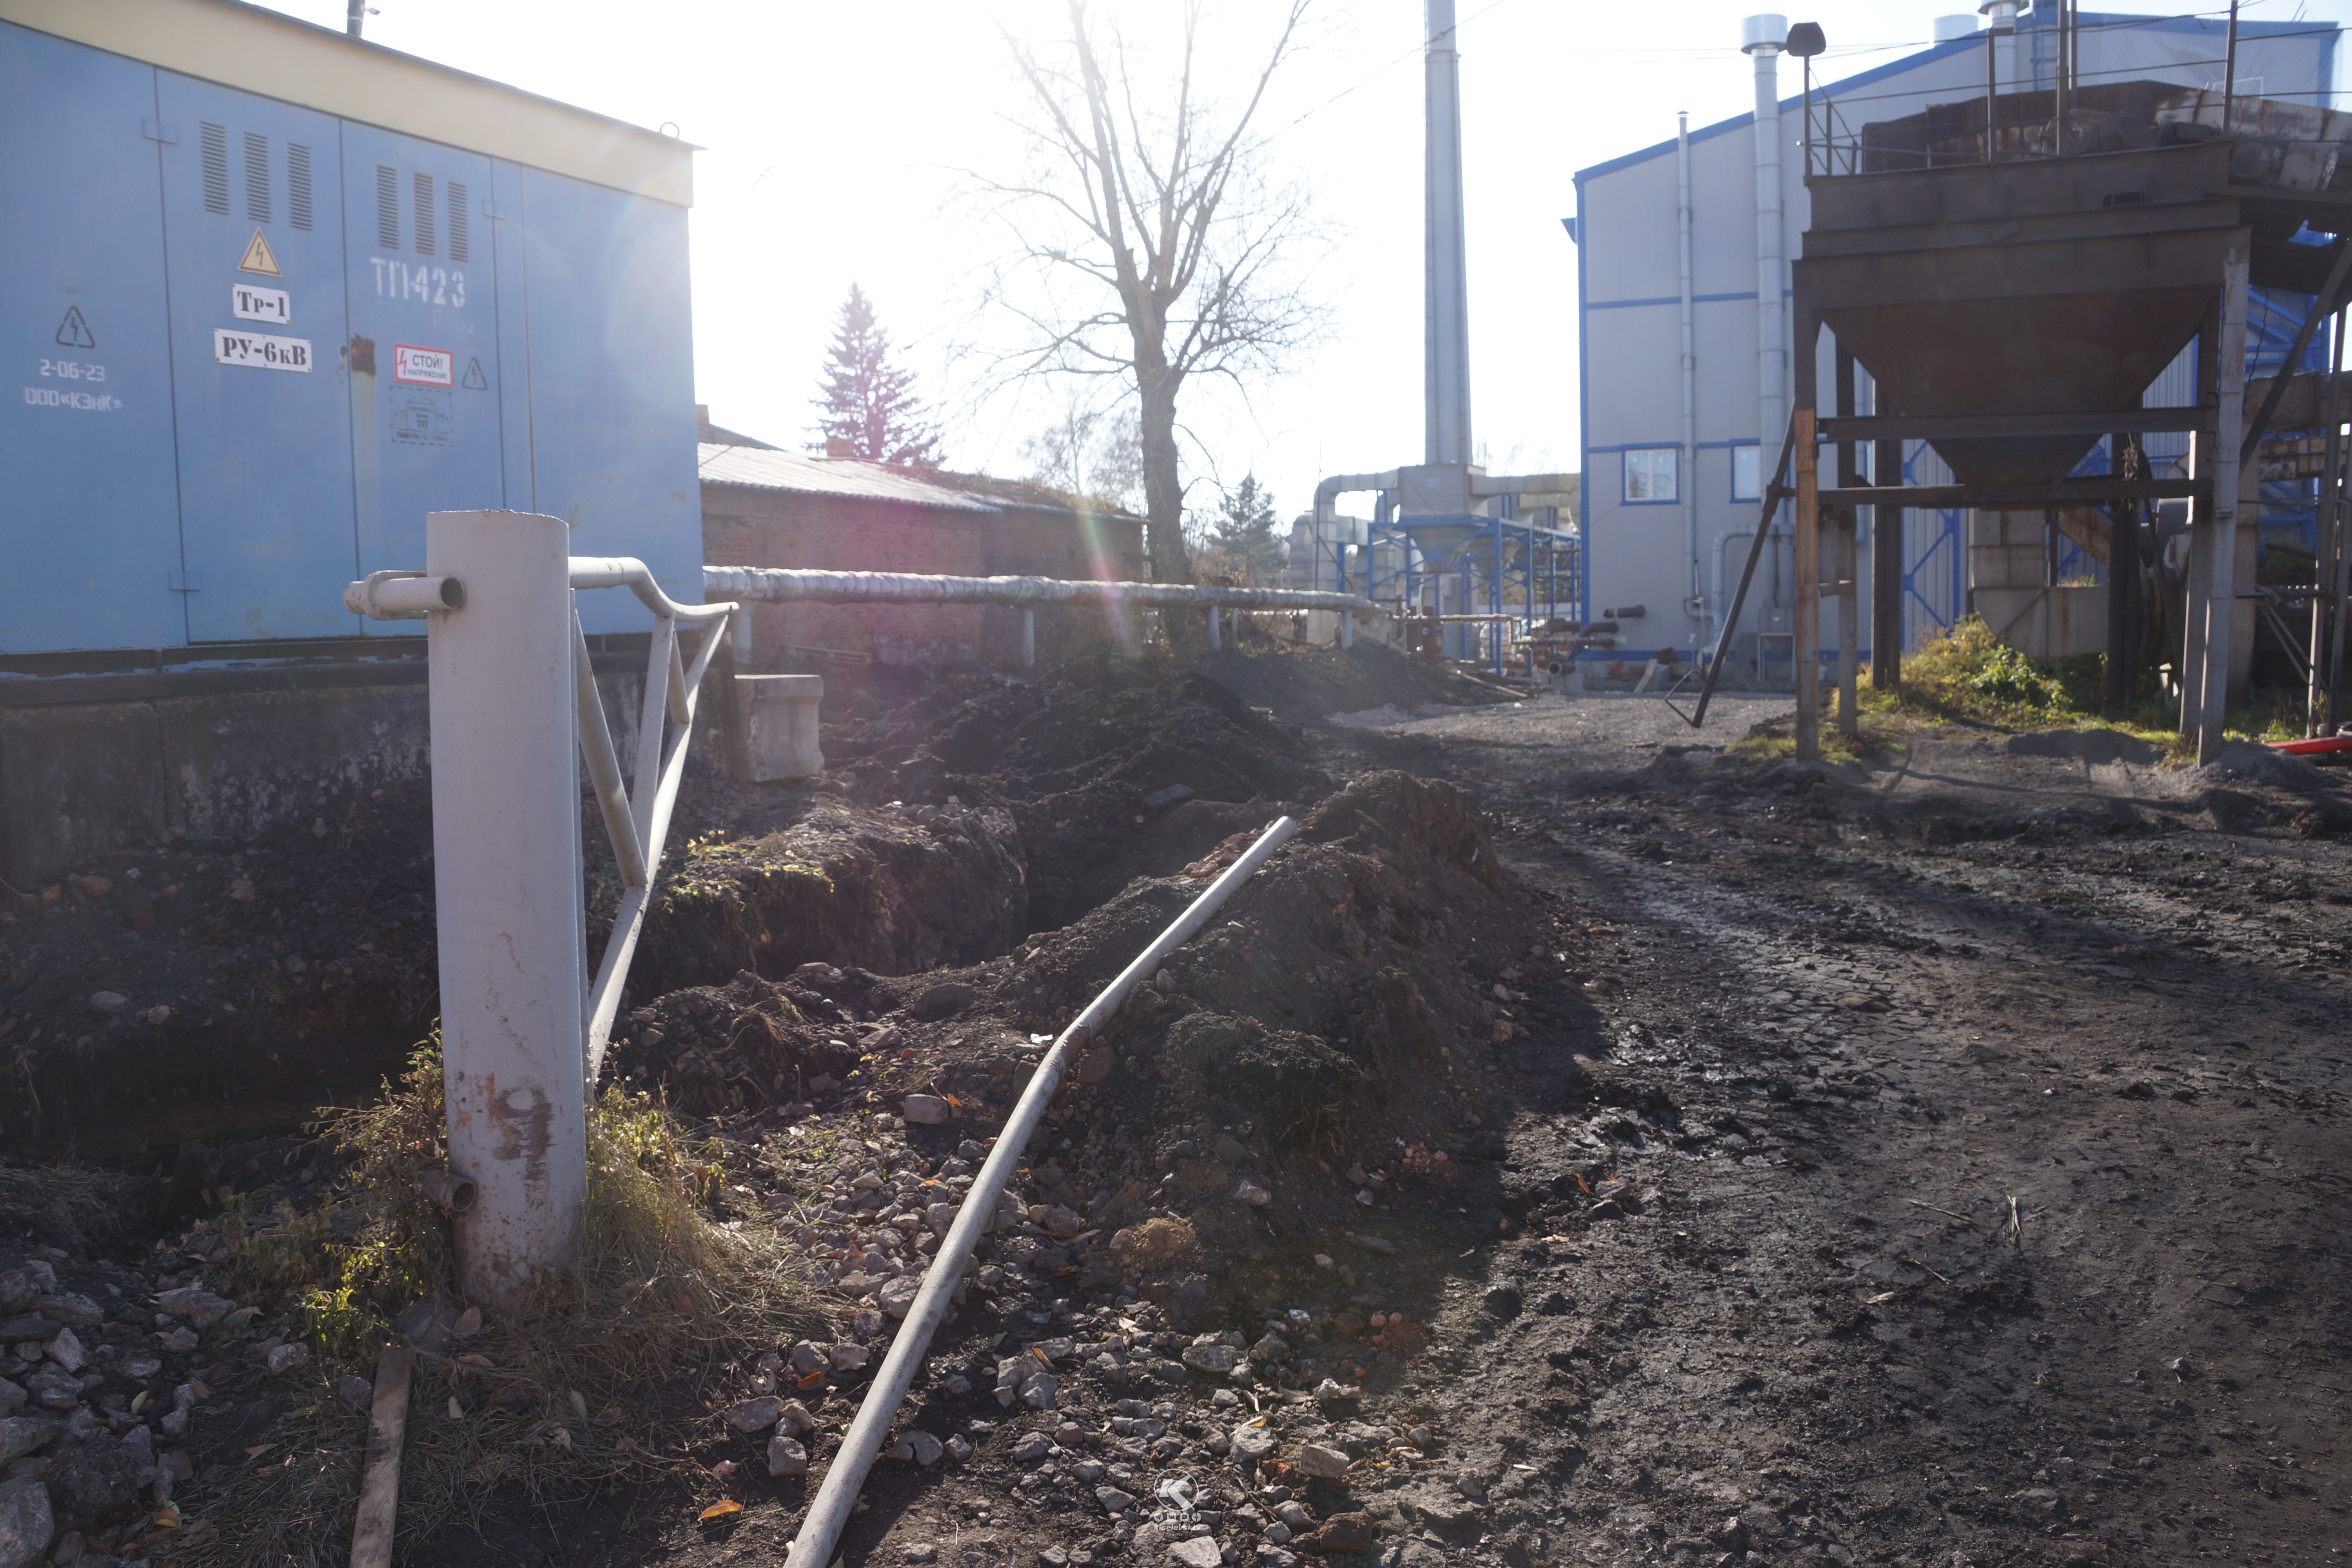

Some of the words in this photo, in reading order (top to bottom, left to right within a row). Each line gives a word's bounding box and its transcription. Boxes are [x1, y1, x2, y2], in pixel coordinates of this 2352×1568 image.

[237, 290, 286, 317] Тр-1
[222, 336, 307, 365] РУ-6кВ
[412, 354, 443, 369] СТОЙ!
[40, 358, 105, 381] 2-06-23
[408, 368, 447, 379] НАПРЯЖЕНИЕ
